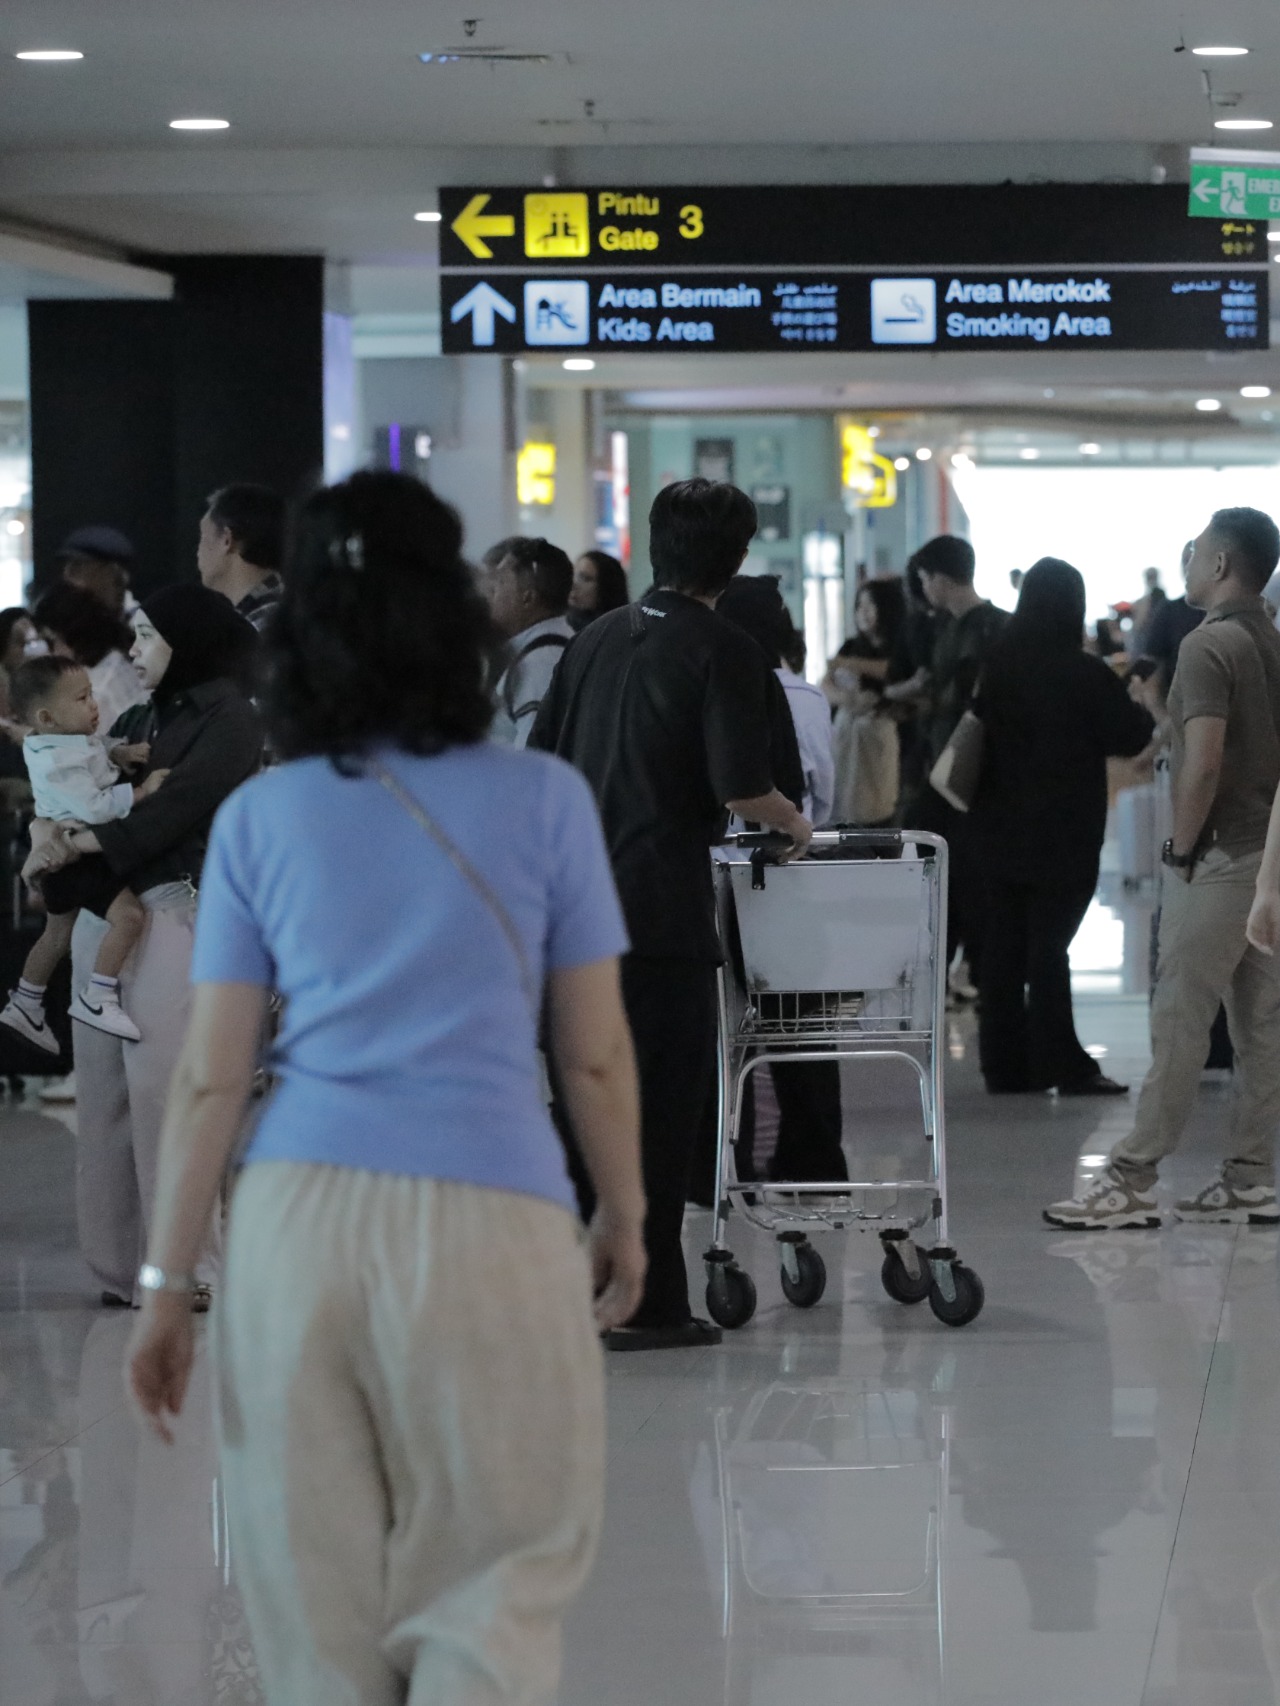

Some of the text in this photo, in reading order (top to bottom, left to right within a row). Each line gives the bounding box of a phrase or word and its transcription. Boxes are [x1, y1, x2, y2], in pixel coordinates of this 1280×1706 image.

[598, 193, 660, 216] Pintu
[679, 204, 705, 240] 3
[598, 226, 660, 252] Gate
[598, 283, 657, 308] Area
[661, 283, 761, 308] Bermain
[946, 278, 1111, 304] Area Merokok
[598, 317, 715, 342] Kids Area
[946, 312, 1112, 342] Smoking Area
